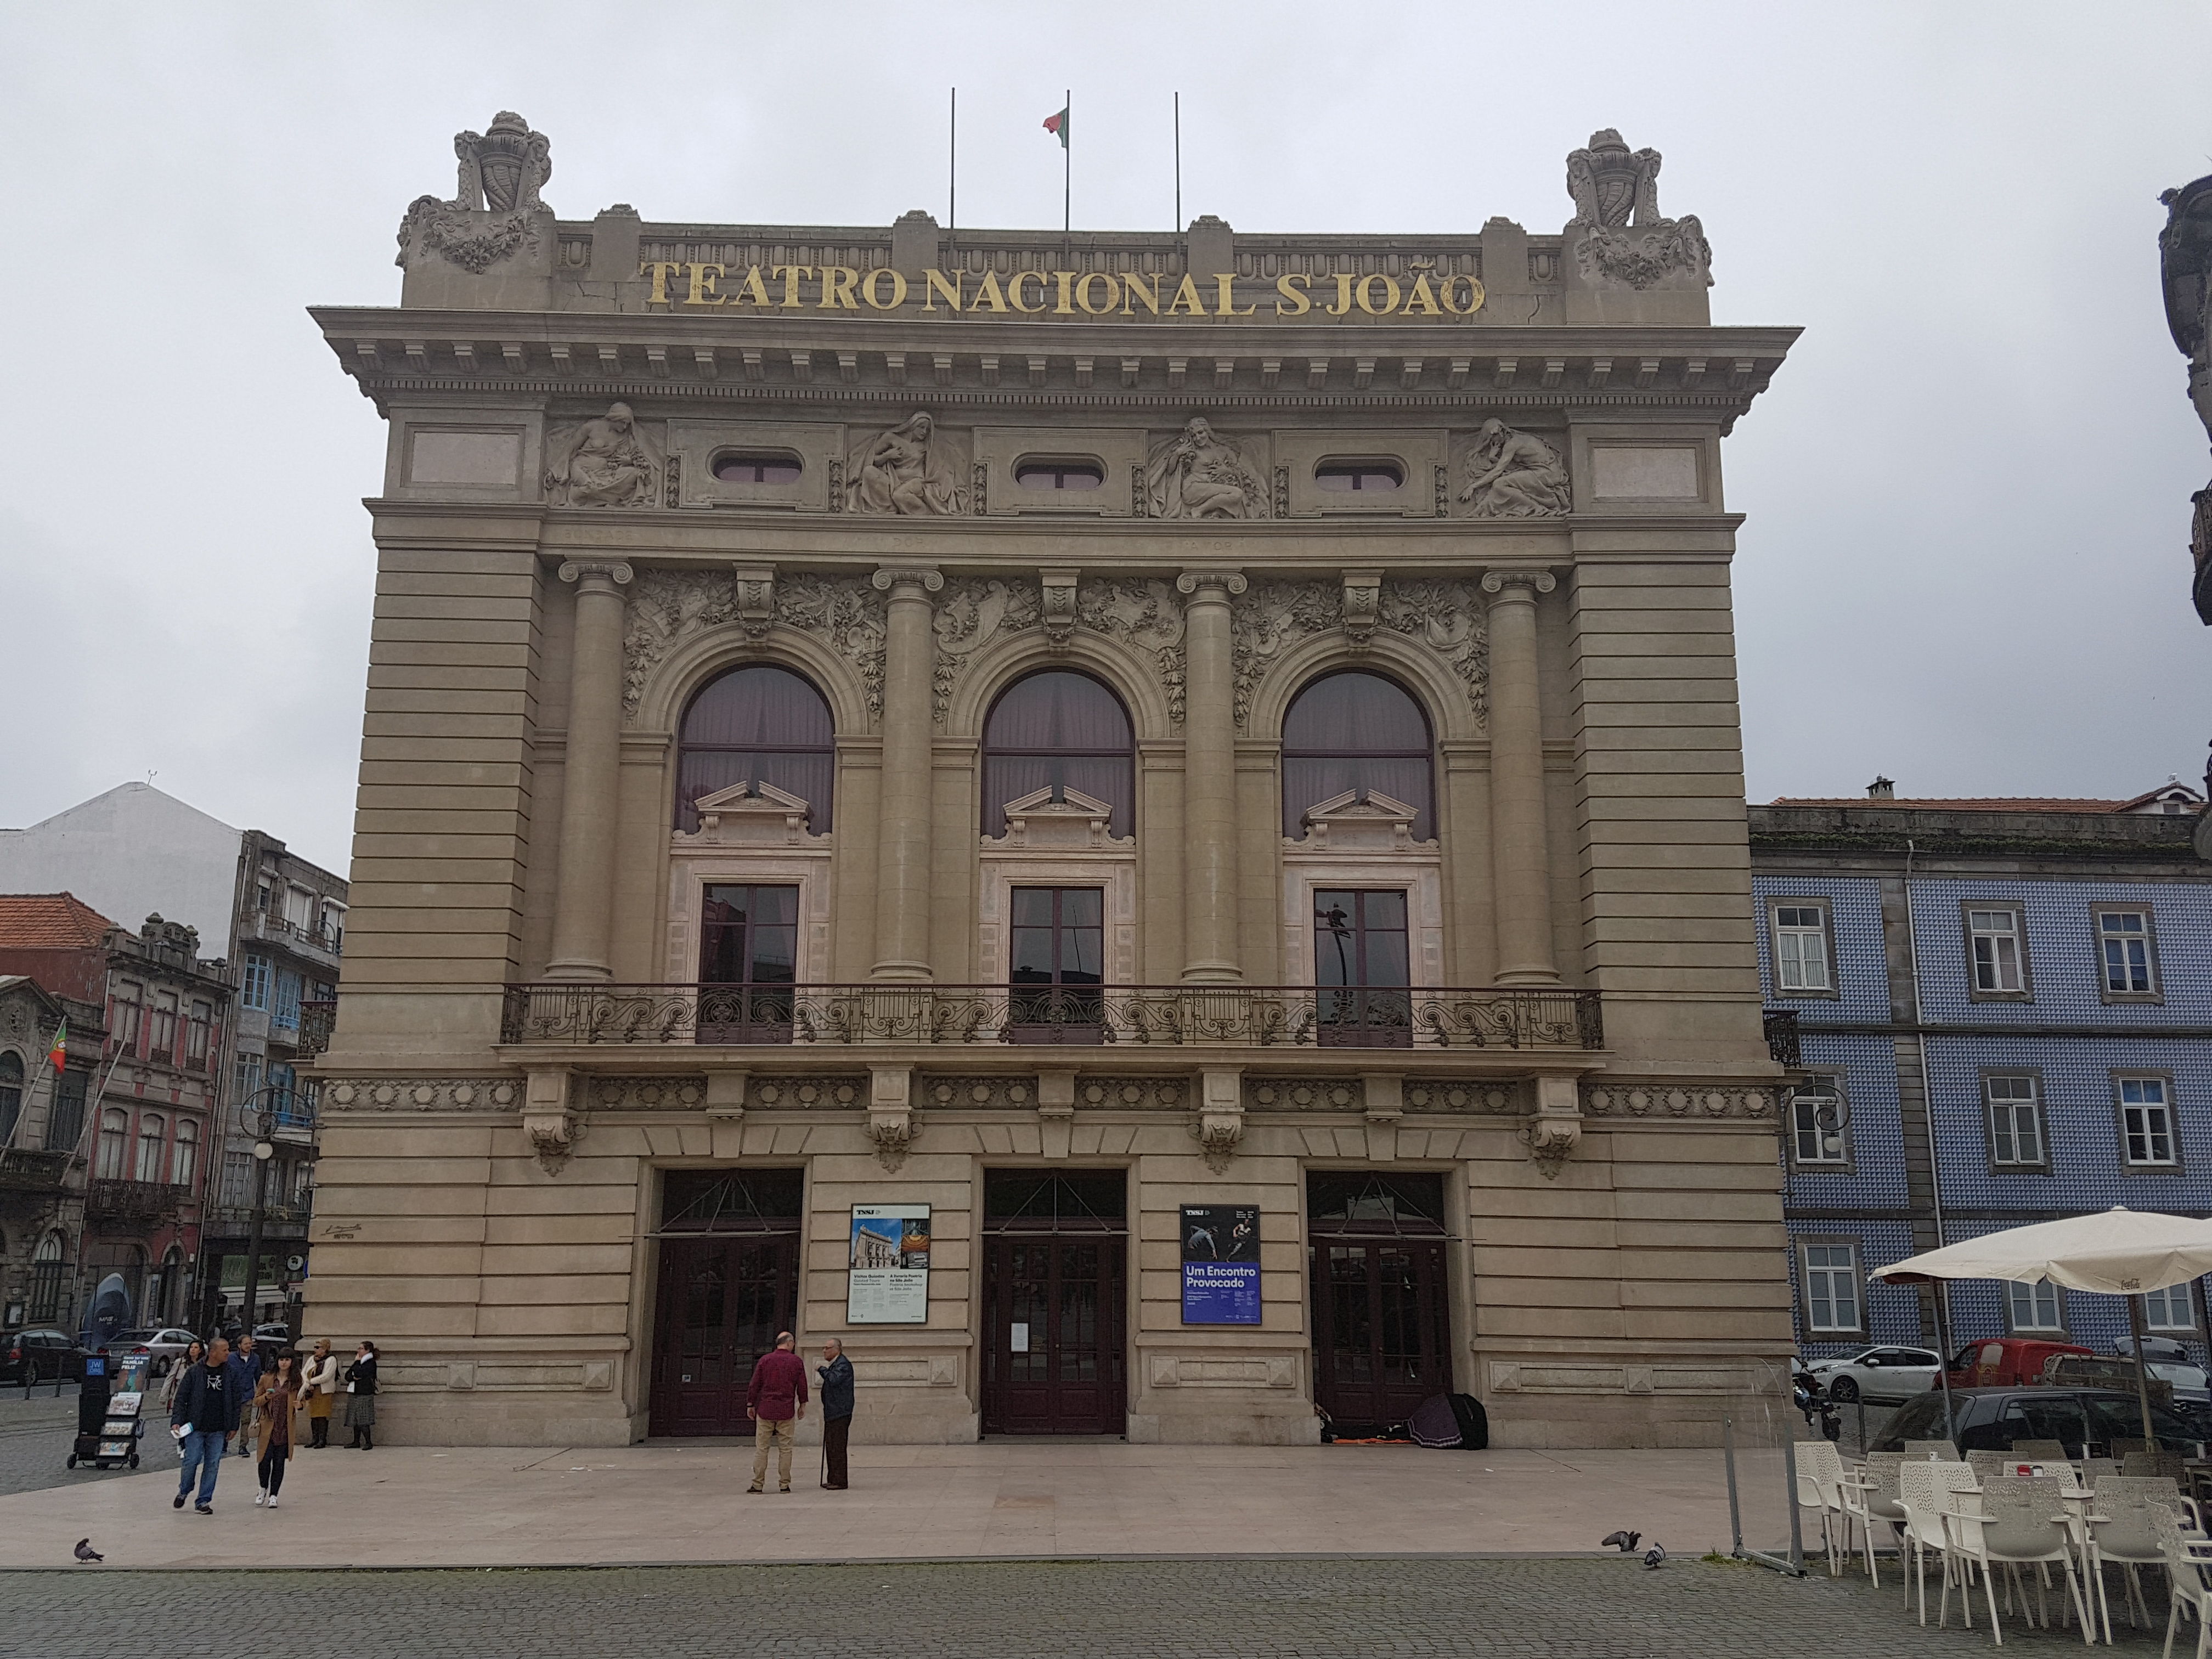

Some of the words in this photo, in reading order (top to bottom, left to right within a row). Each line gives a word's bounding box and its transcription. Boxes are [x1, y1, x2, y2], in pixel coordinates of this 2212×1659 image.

[640, 262, 907, 310] TEATRO
[921, 268, 1257, 316] NACIONAL
[1187, 1266, 1205, 1276] Um
[1207, 1266, 1256, 1277] Encontro
[1187, 1277, 1245, 1288] Provocado
